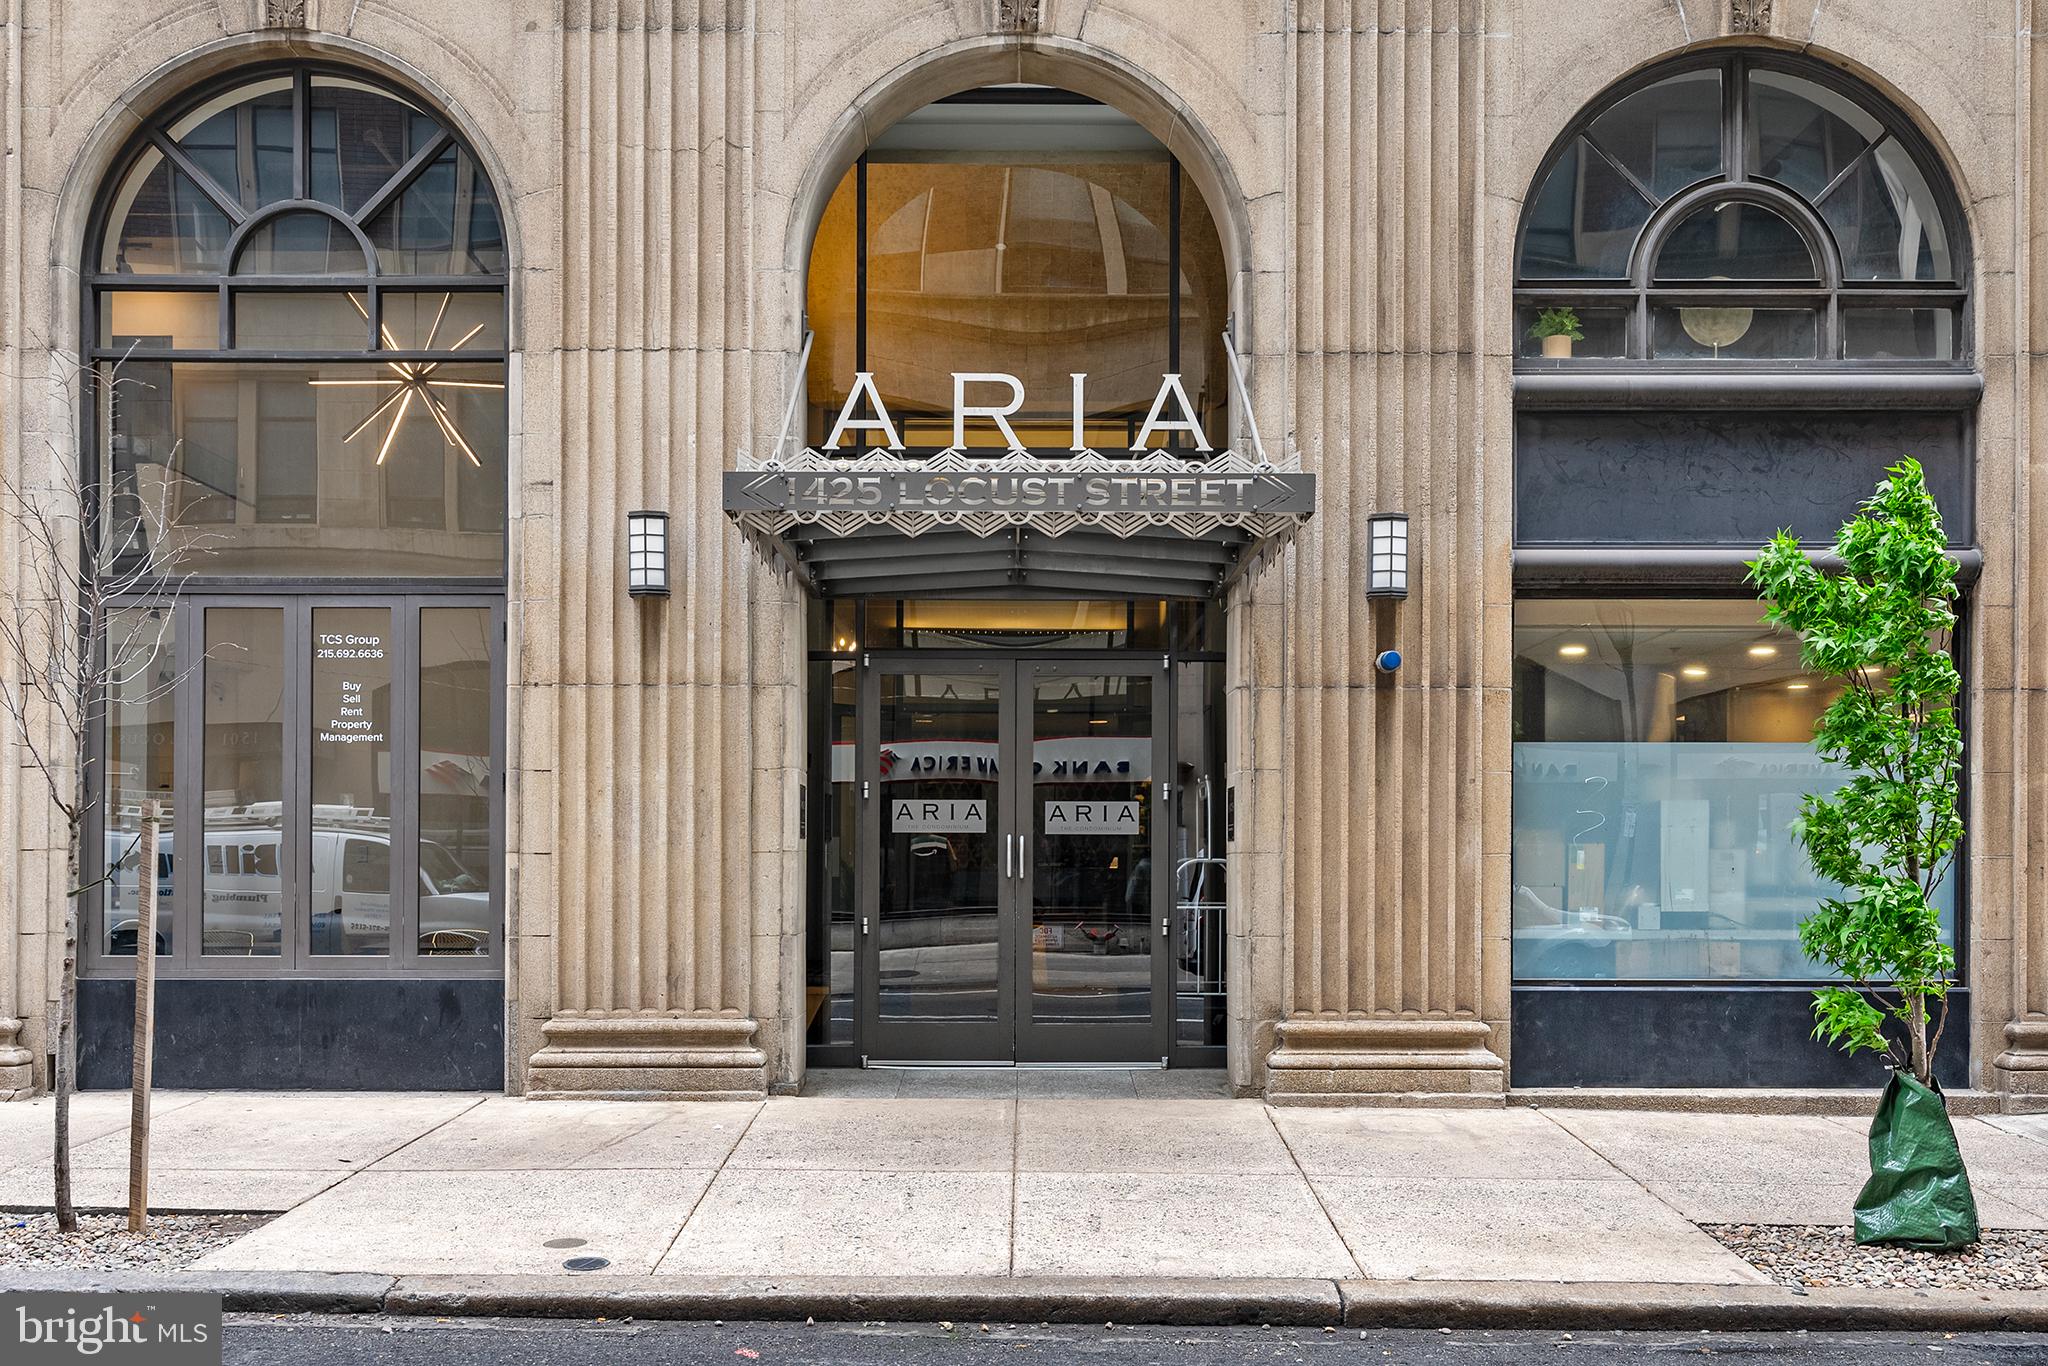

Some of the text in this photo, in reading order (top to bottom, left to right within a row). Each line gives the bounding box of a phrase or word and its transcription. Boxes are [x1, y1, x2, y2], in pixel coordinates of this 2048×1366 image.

[821, 372, 1214, 451] ARIA
[787, 476, 1253, 505] 1425 LOCUST STREET
[320, 634, 380, 646] TCS Group
[317, 649, 384, 659] 215.692.6636
[342, 681, 362, 692] Buy
[342, 694, 361, 703] Sell
[340, 707, 363, 716] Rent
[331, 720, 372, 730] Property
[320, 732, 384, 743] Management
[896, 803, 982, 820] ARIA
[1049, 805, 1135, 822] ARIA
